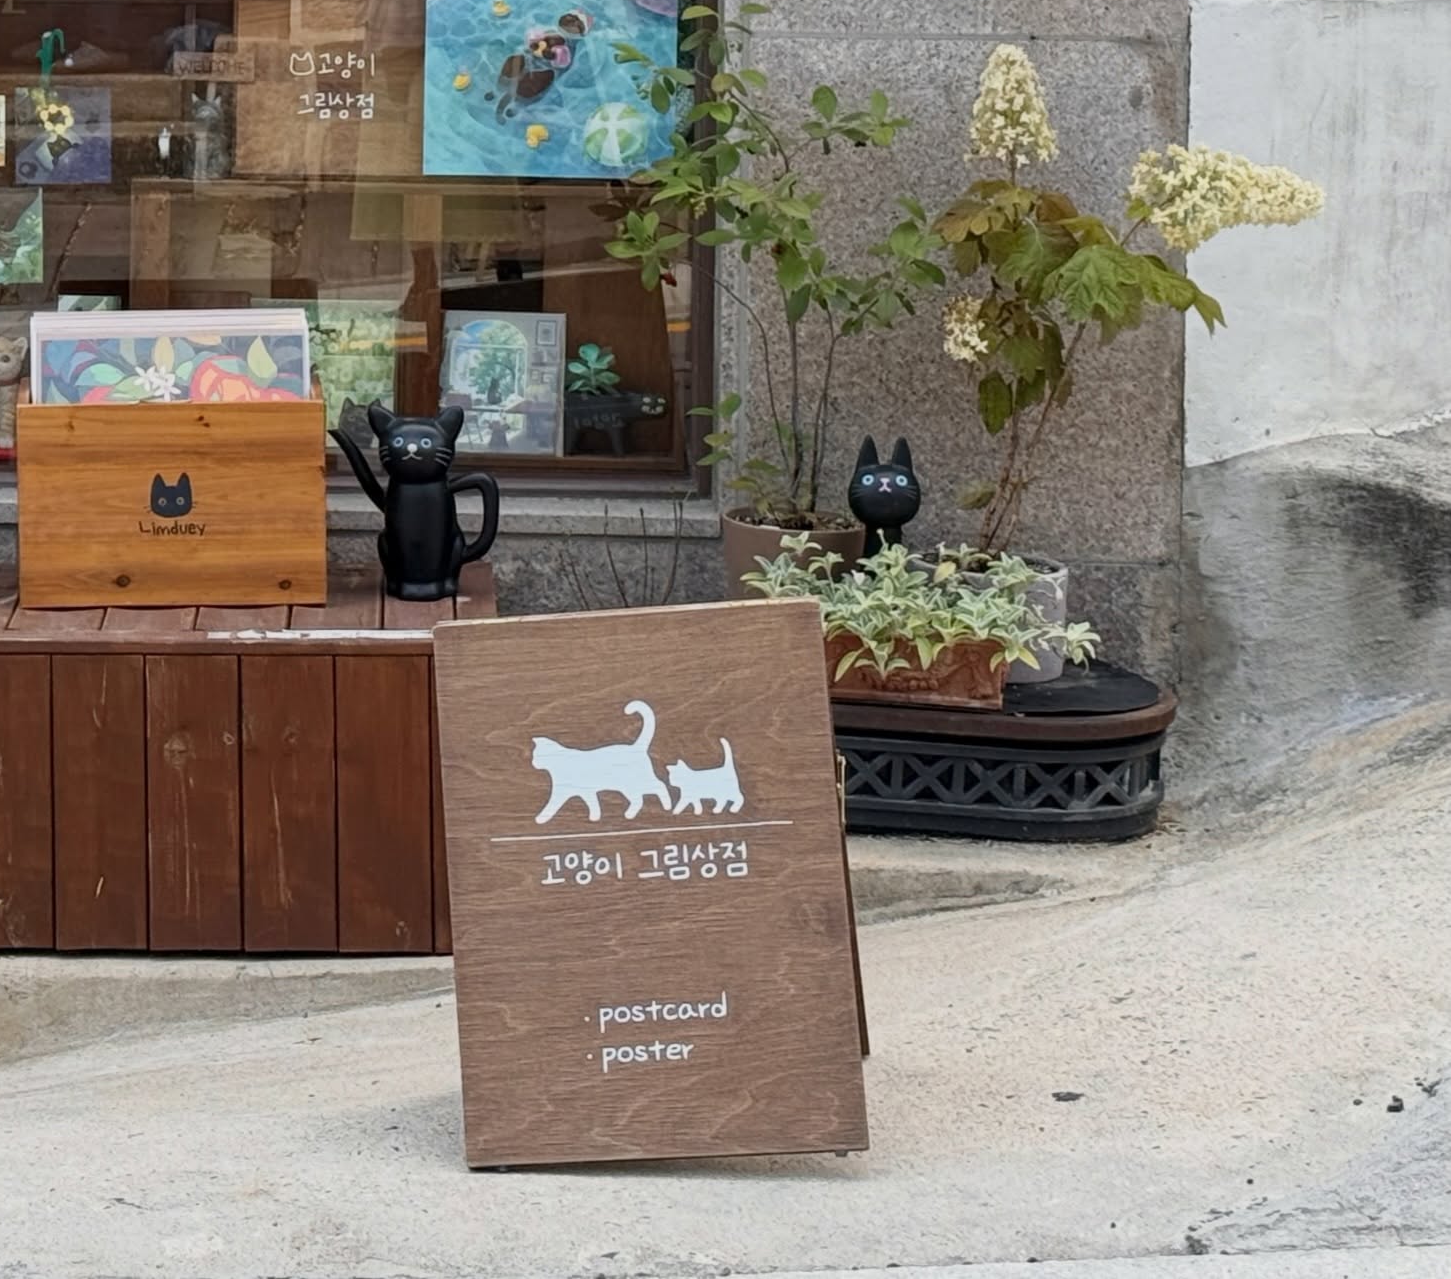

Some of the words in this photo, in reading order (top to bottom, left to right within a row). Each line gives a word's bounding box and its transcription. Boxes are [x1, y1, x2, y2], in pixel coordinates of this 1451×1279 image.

[317, 51, 376, 79] 고양이
[297, 92, 375, 119] 그림상점
[138, 520, 206, 537] Limduey
[541, 850, 623, 885] 고양이
[638, 840, 748, 881] 그림상점
[599, 990, 728, 1034] postcard
[602, 1040, 694, 1074] poster
